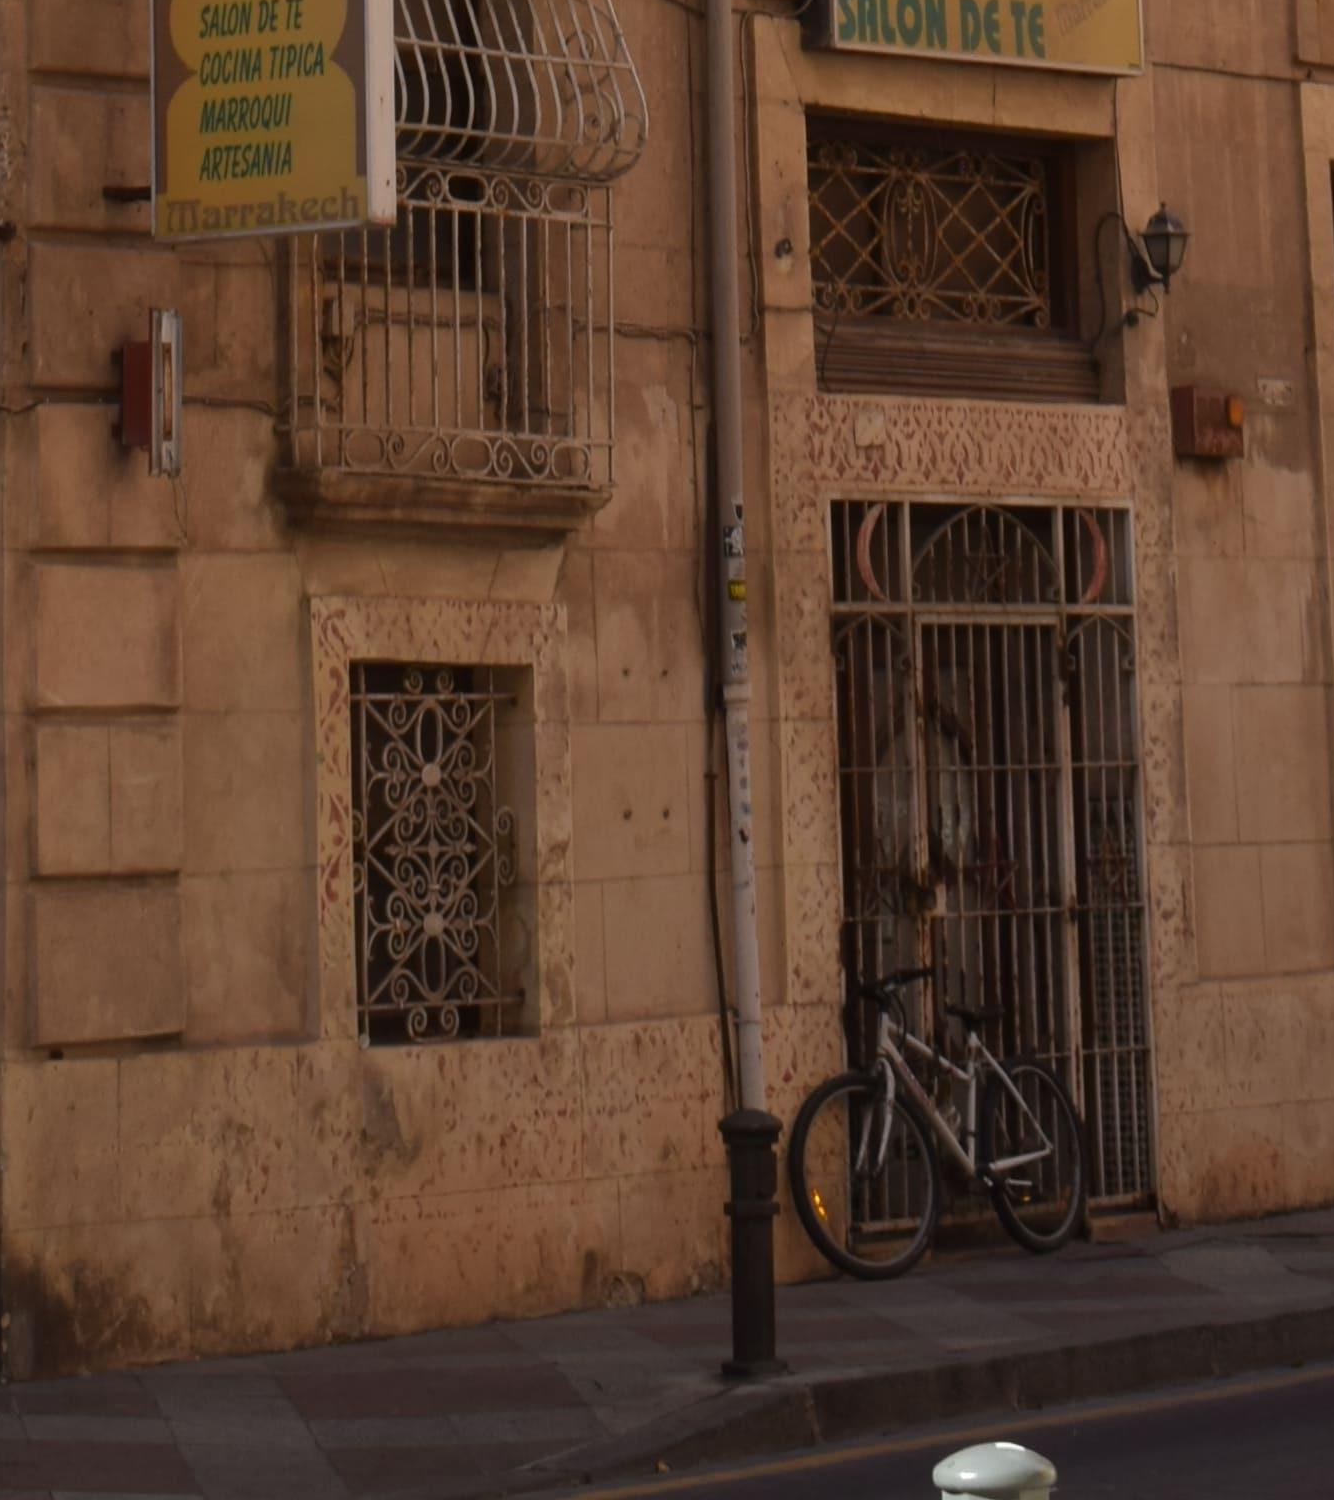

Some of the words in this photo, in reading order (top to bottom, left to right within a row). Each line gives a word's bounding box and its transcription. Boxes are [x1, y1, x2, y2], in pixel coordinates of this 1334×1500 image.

[199, 0, 251, 39] SALON
[257, 0, 280, 34] DE
[1010, 0, 1046, 59] TE
[200, 48, 262, 86] COCINA
[268, 41, 325, 79] TIPICA
[199, 93, 292, 134] MARROQUI
[199, 140, 292, 182] ARTESANIA
[166, 186, 360, 234] Marrakech
